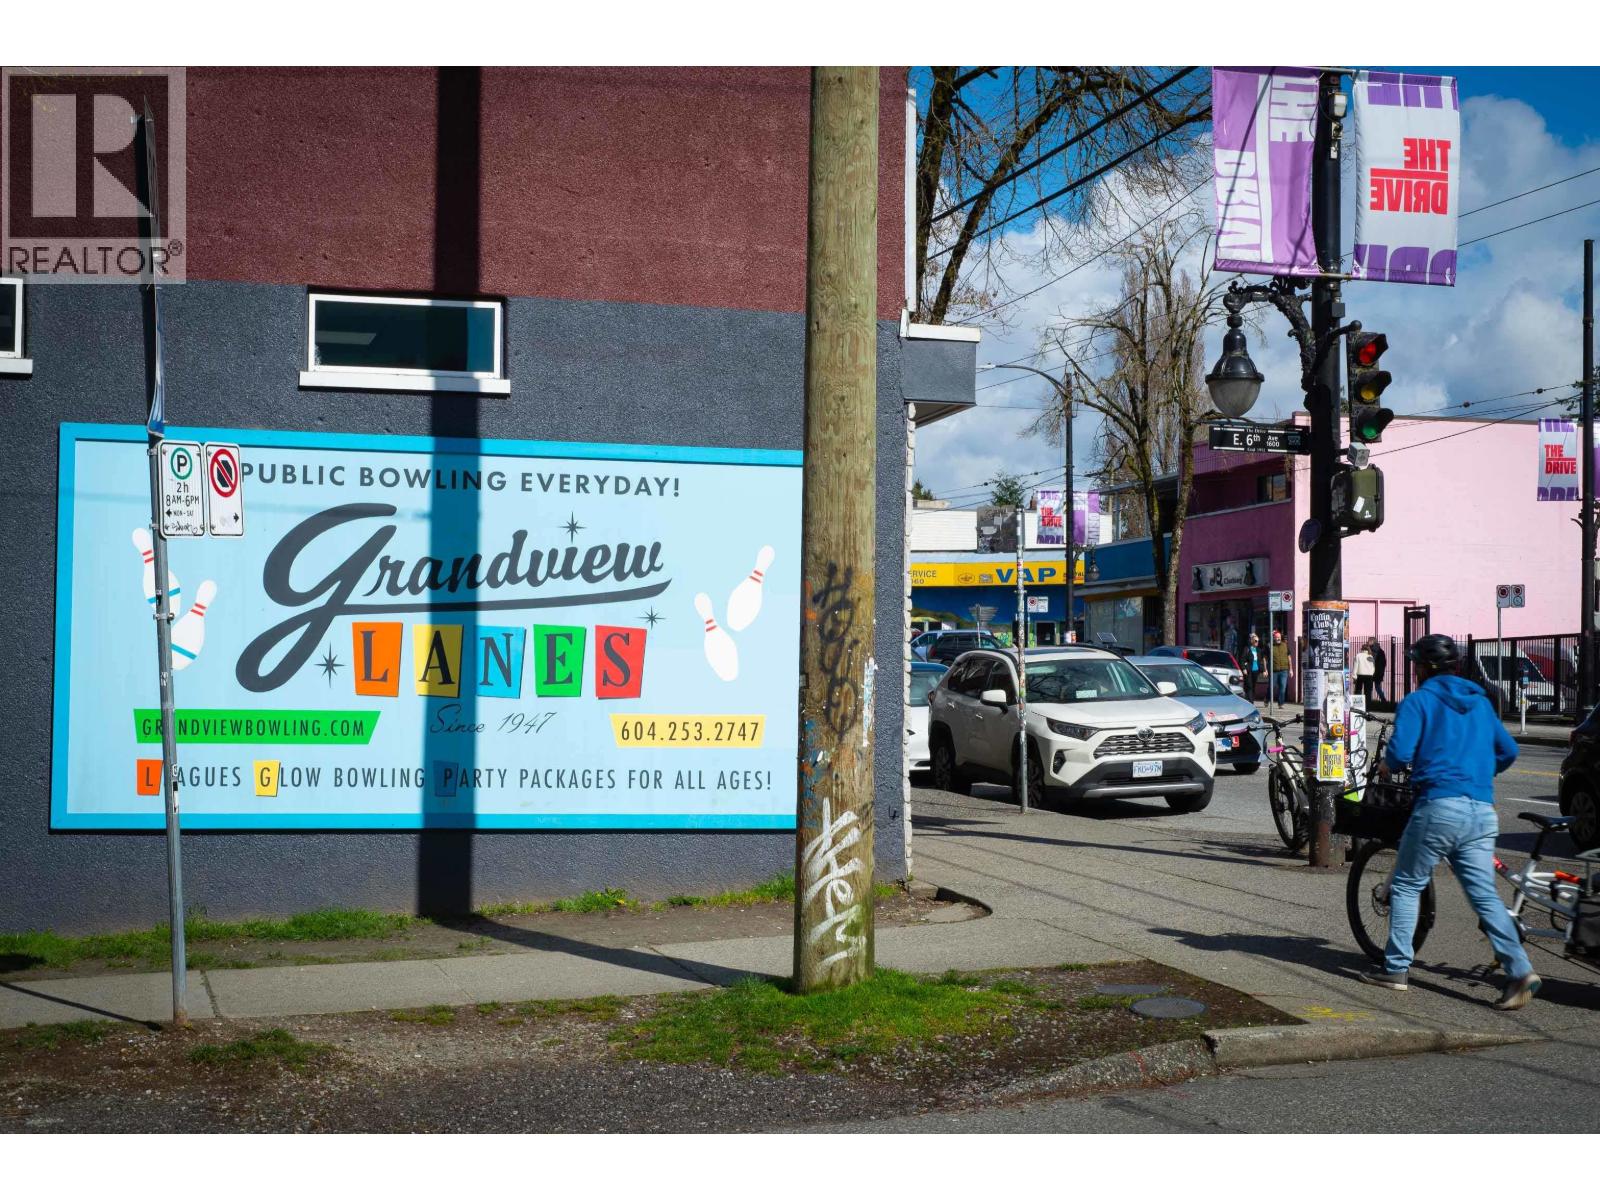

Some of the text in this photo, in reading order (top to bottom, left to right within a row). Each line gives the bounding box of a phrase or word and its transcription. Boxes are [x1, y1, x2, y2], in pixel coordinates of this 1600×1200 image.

[1233, 433, 1243, 446] E.
[1246, 434, 1261, 446] 6th
[1544, 444, 1564, 458] THE
[177, 454, 188, 473] P
[1545, 461, 1577, 475] DRIVE
[242, 462, 681, 498] PUBLIC BOWLING EVERYDAY!
[907, 569, 937, 578] ERVICE
[359, 629, 632, 688] LANES
[142, 718, 365, 738] GRNDVIEWBOWLING.COM
[429, 703, 558, 735] Since 1947
[621, 719, 760, 742] 604.253.2747
[145, 766, 772, 791] LAGUES GLOW BOWLING PARTY PACKAGES FOR ALL AGES!
